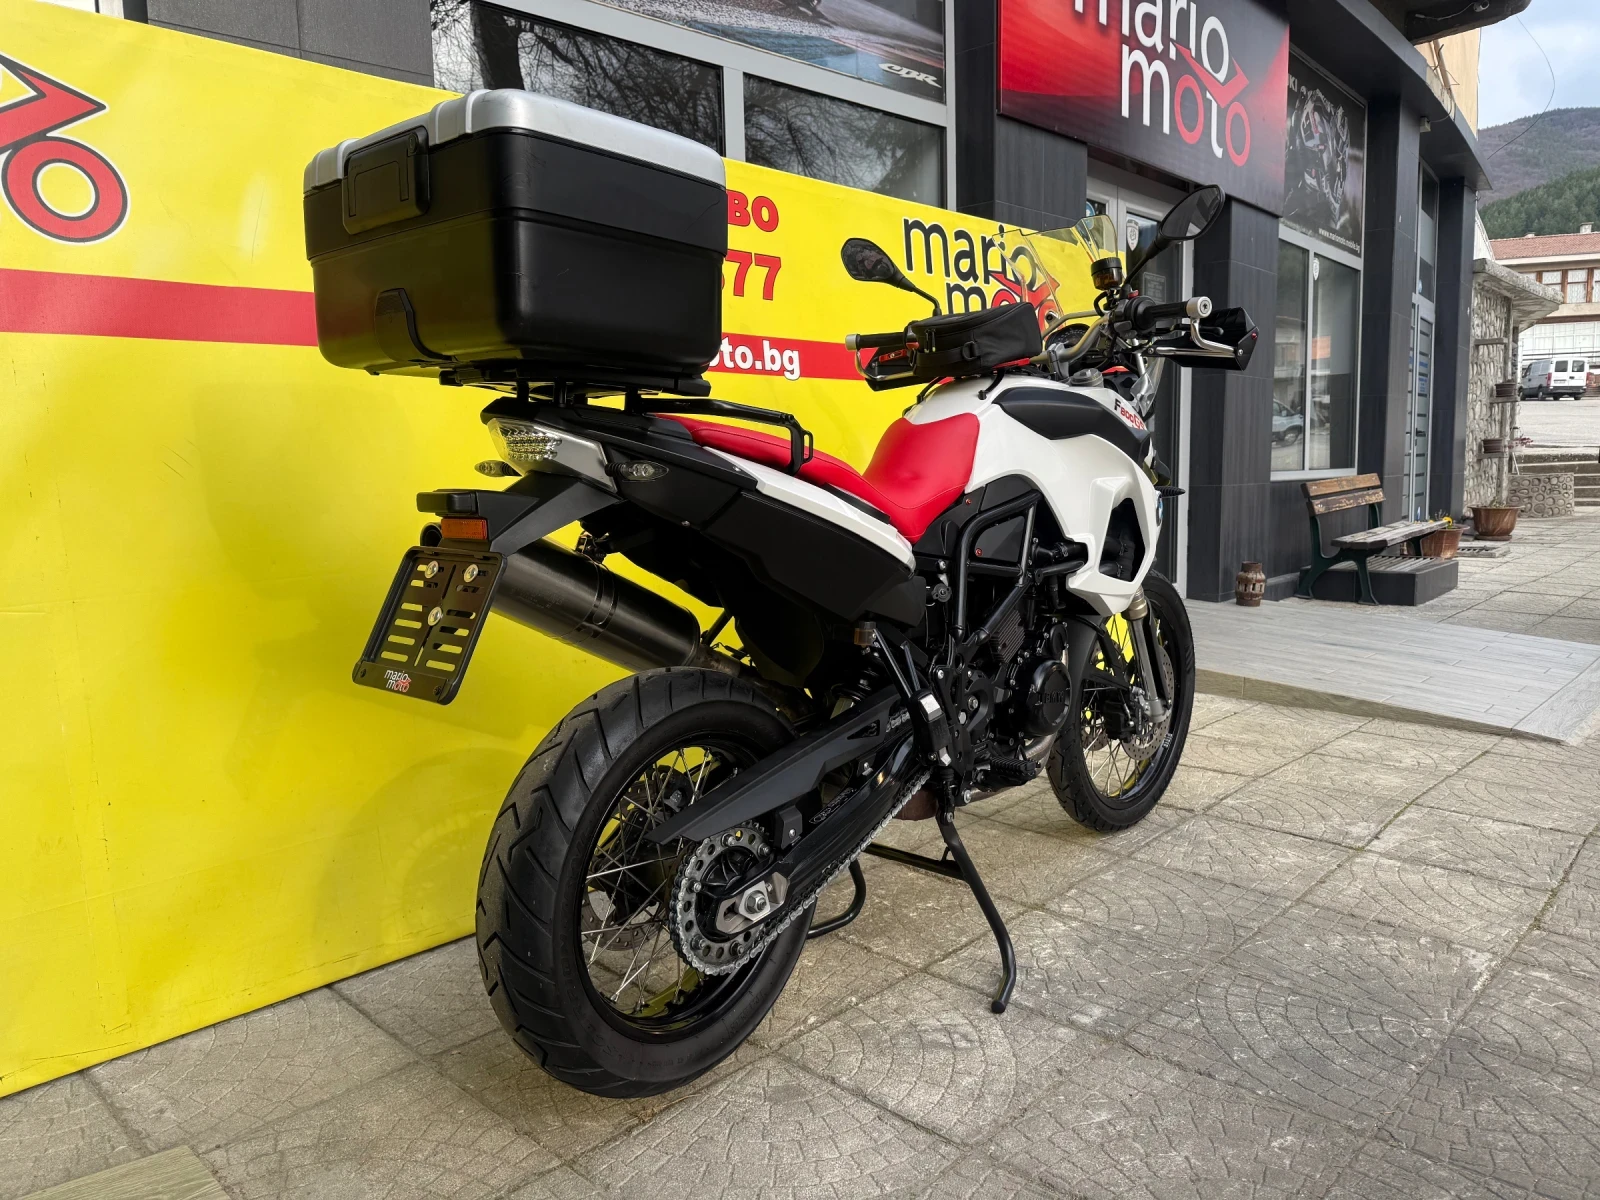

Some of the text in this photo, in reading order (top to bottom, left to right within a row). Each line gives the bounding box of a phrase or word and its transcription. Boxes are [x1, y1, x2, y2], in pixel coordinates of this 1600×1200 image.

[1121, 43, 1251, 167] moto
[721, 248, 782, 301] 77
[903, 218, 1037, 291] mario
[384, 669, 409, 681] mario
[386, 679, 410, 692] moto
